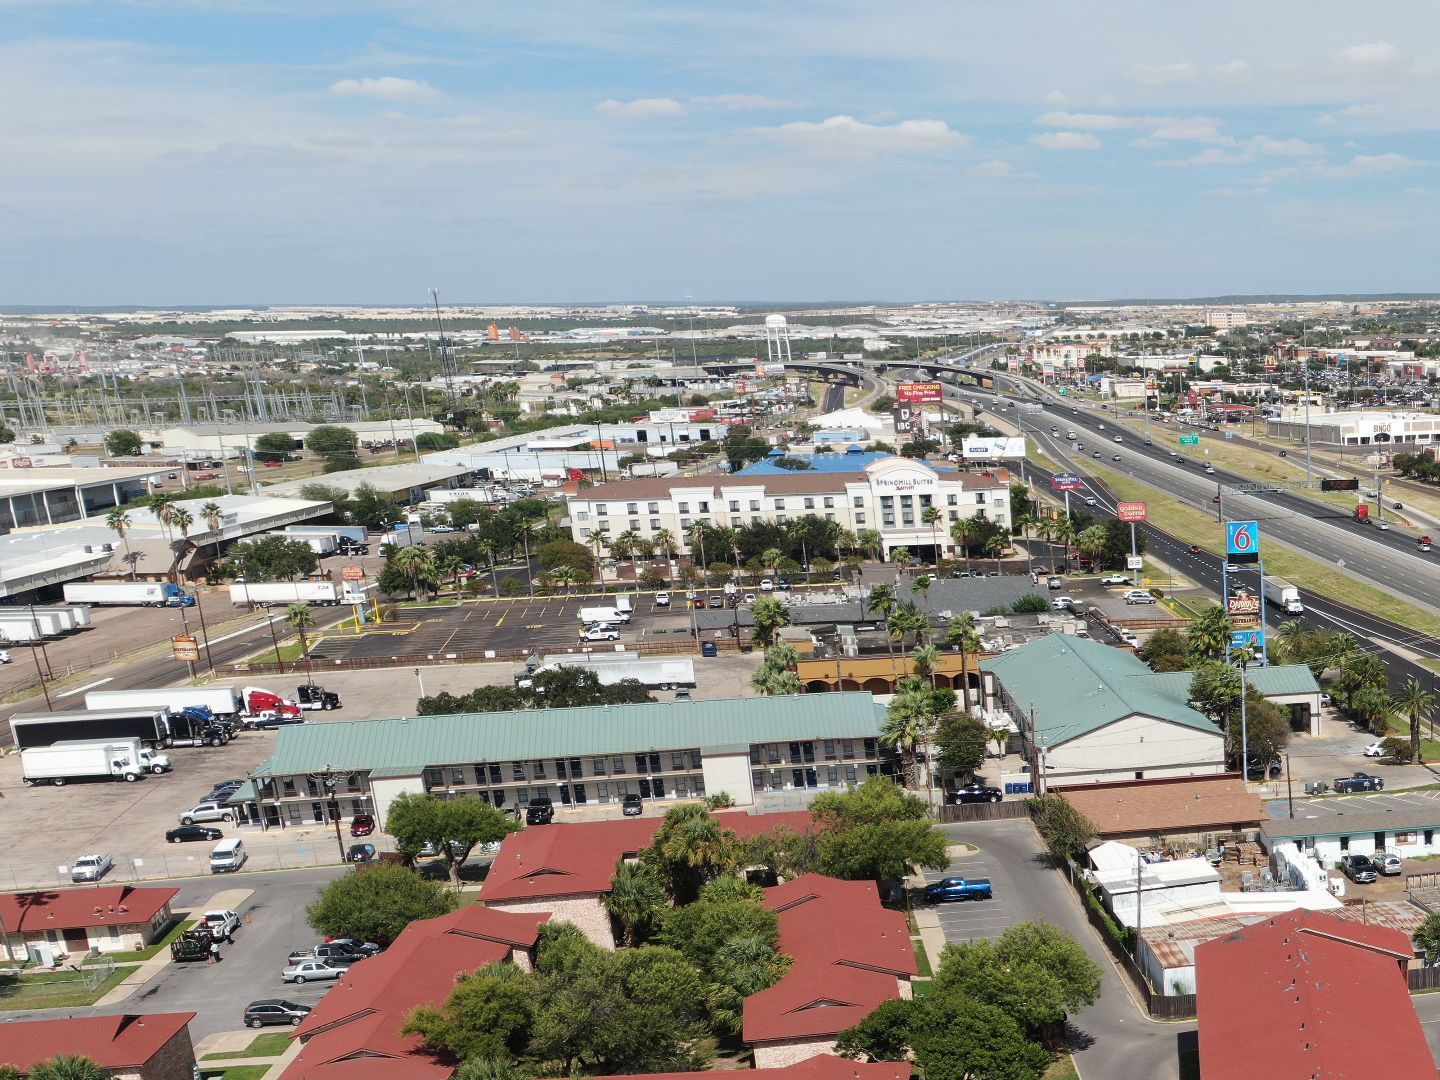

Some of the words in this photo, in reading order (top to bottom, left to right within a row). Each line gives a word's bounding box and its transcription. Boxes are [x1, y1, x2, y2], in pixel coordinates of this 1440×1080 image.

[897, 422, 911, 430] IBC
[1373, 424, 1392, 433] BINGO
[1233, 524, 1251, 551] 6
